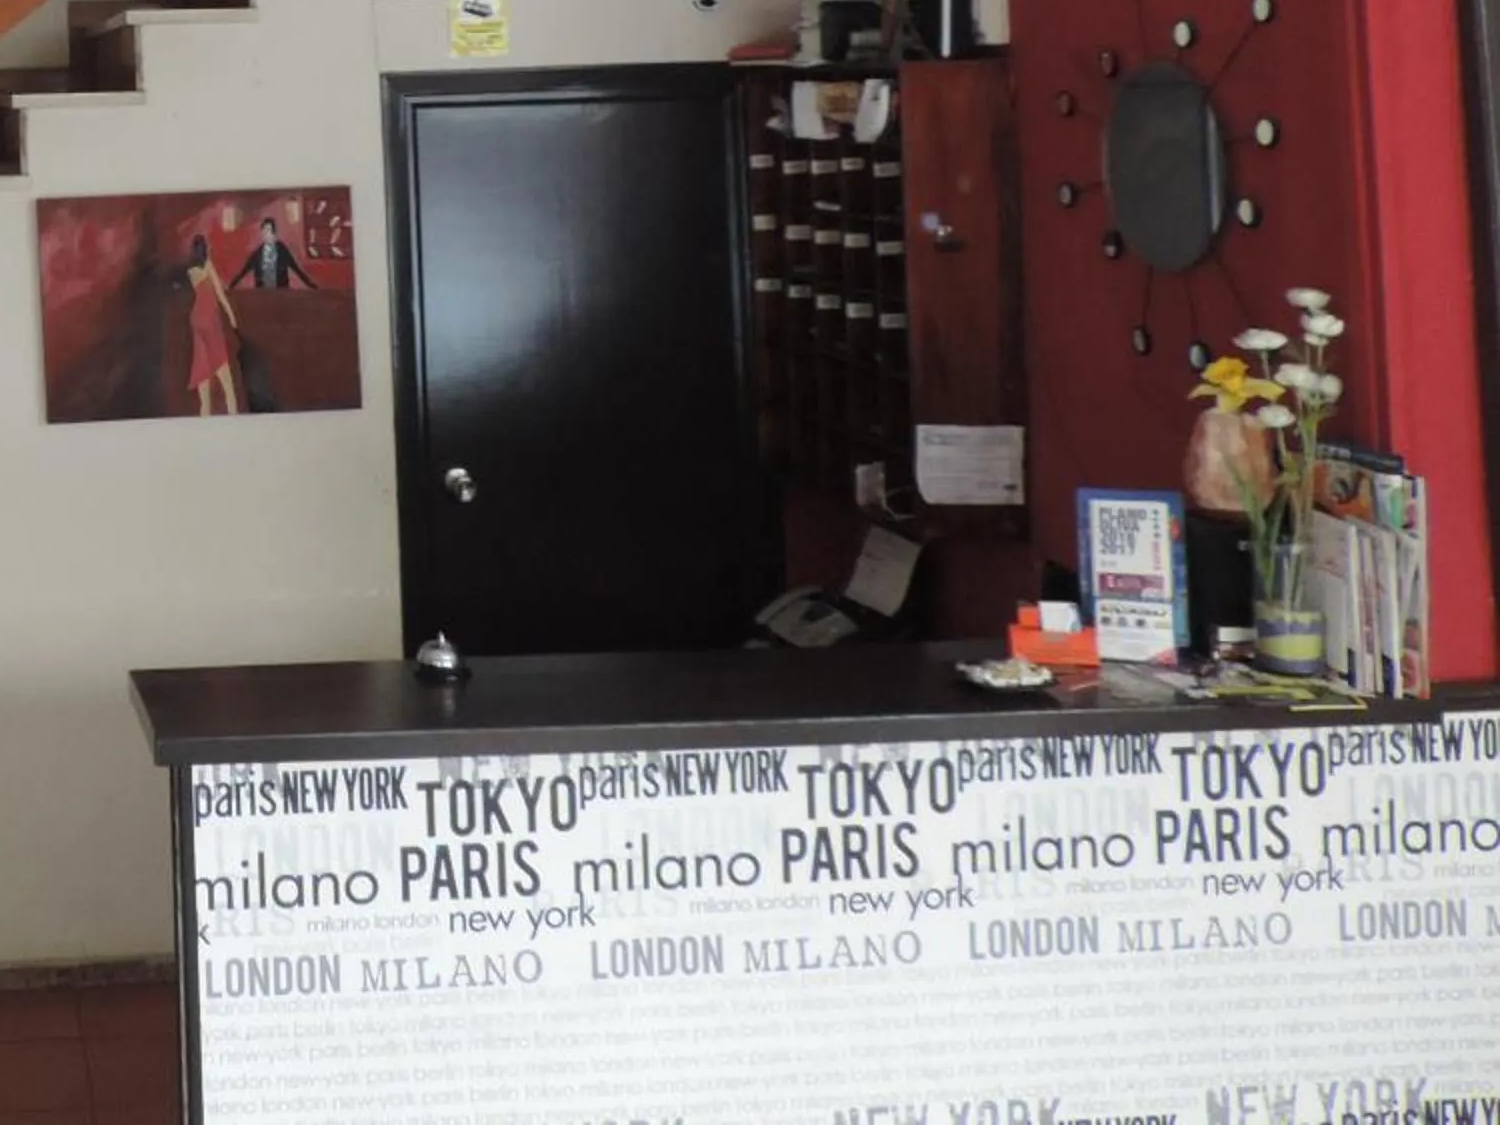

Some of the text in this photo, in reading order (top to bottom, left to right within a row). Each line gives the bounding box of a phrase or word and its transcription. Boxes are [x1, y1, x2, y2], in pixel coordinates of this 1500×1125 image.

[194, 768, 277, 828] paris
[281, 768, 337, 815] NEW
[341, 765, 409, 812] YORK
[416, 773, 578, 839] TOKYO
[579, 752, 660, 810] paris
[665, 751, 721, 796] NEW
[724, 748, 789, 794] YORK
[797, 756, 957, 820] TOKYO
[957, 743, 1038, 793] paris
[1041, 737, 1096, 779] NEW
[1098, 735, 1163, 777] YORK
[1170, 740, 1328, 802] TOKYO
[1328, 728, 1407, 776] paris
[1410, 718, 1465, 763] NEW
[196, 797, 1500, 911] milano PARIS milano PARIS milano PARIS milano
[449, 907, 516, 934] new
[526, 891, 596, 940] york
[829, 887, 894, 915] new
[905, 871, 975, 921] york
[1202, 869, 1267, 896] new
[1276, 853, 1344, 904] york
[205, 953, 341, 999] LONDON
[360, 949, 544, 994] MILANO
[590, 934, 725, 980] LONDON
[742, 930, 922, 974] MILANO
[968, 916, 1100, 961] LONDON
[1116, 911, 1292, 954] MILANO
[1338, 898, 1467, 942] LONDON
